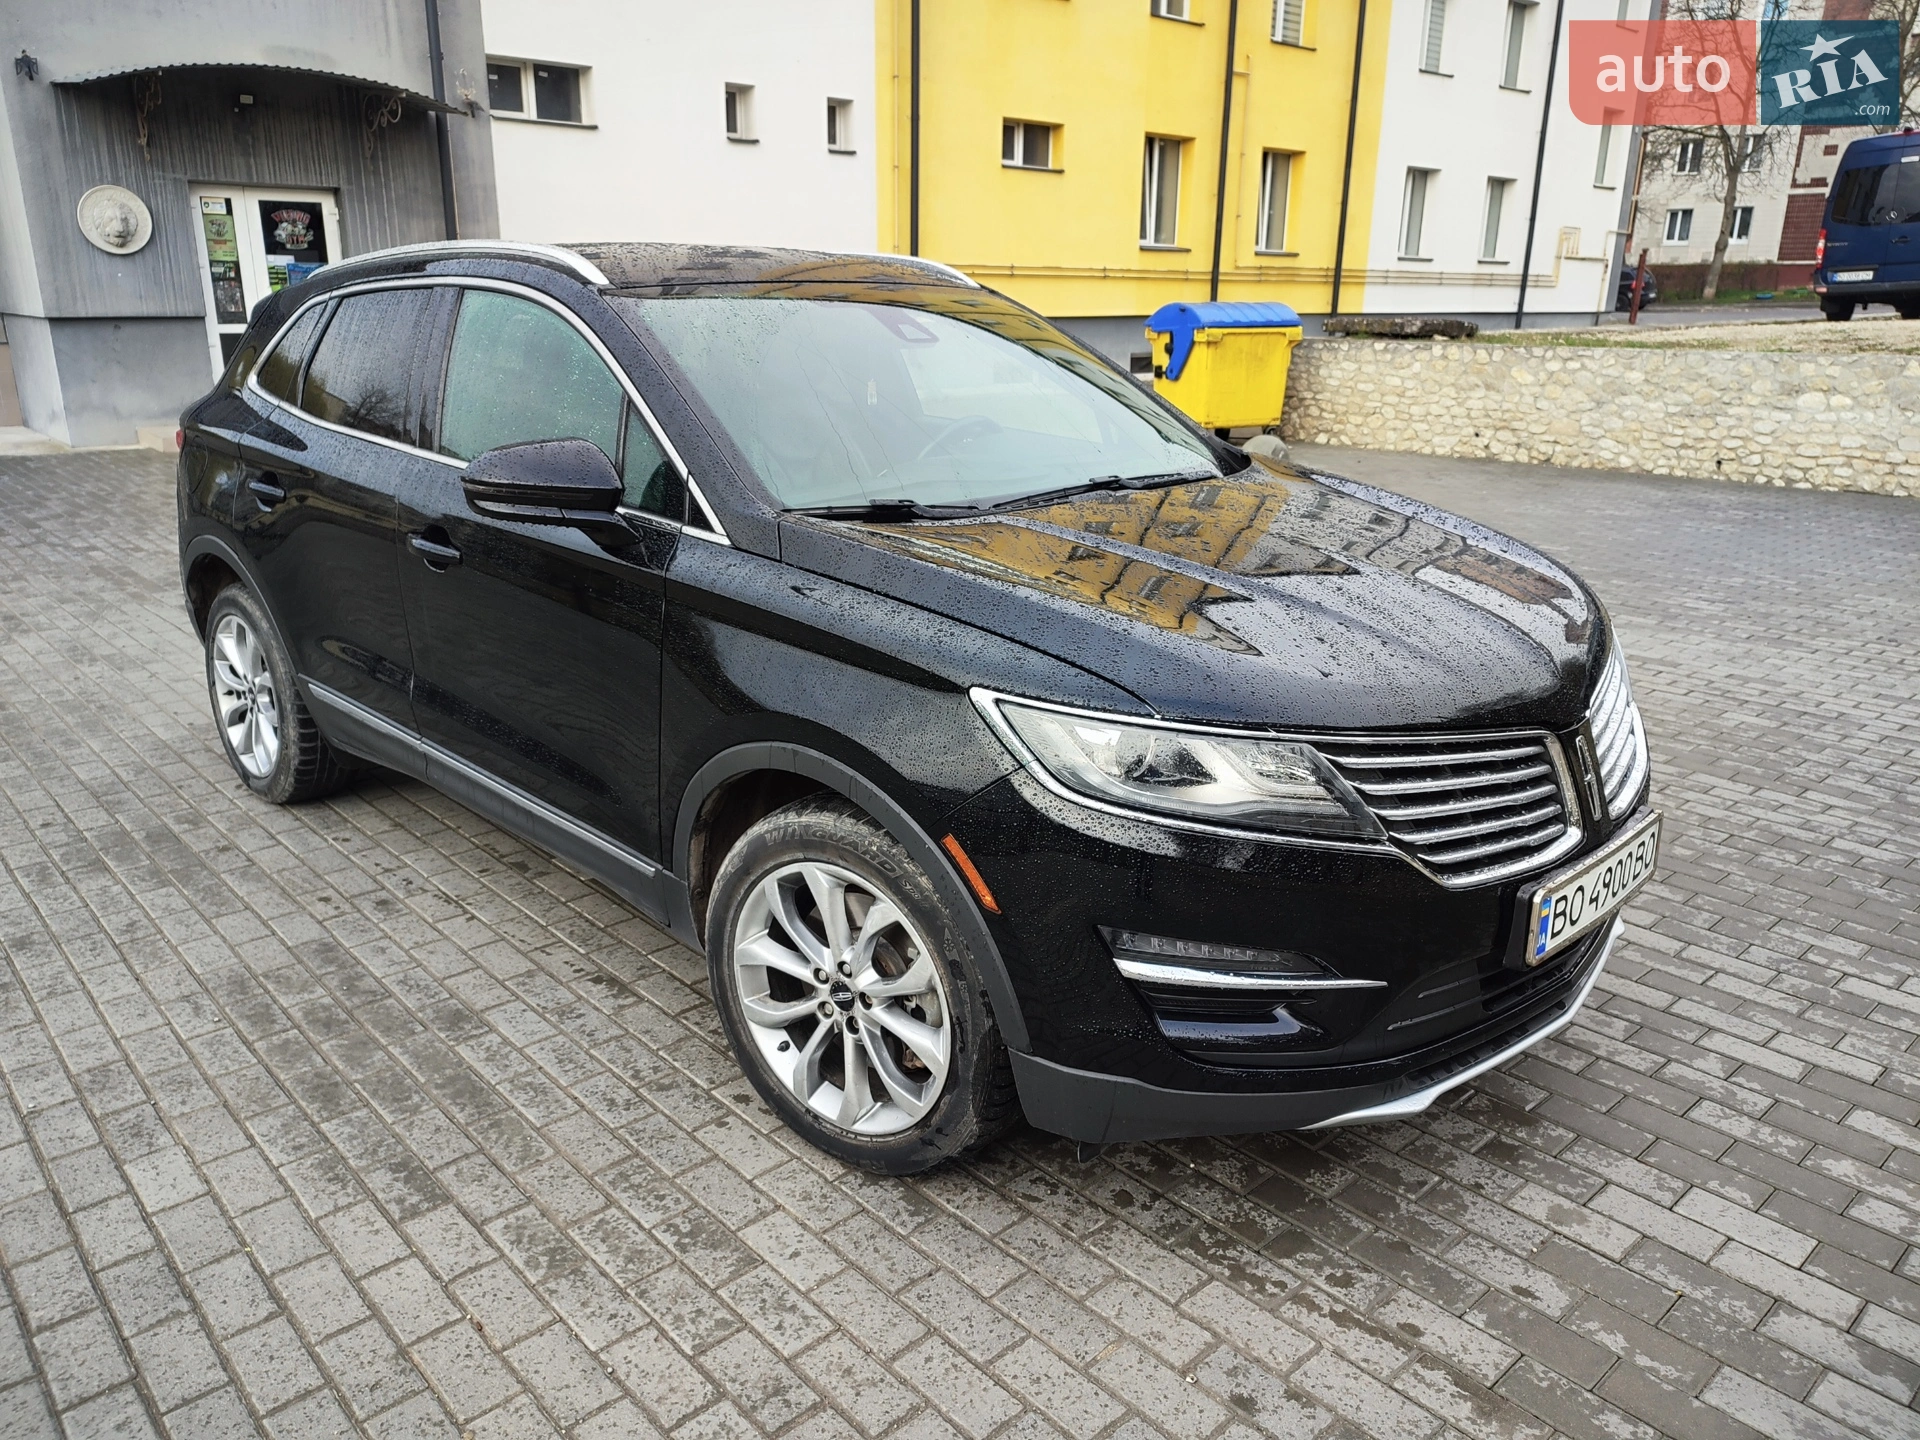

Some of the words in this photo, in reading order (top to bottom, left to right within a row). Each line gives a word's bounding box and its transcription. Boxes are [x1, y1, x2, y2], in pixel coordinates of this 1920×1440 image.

[1550, 884, 1585, 940] BO
[1589, 851, 1633, 912] 4900
[1632, 831, 1656, 883] BO
